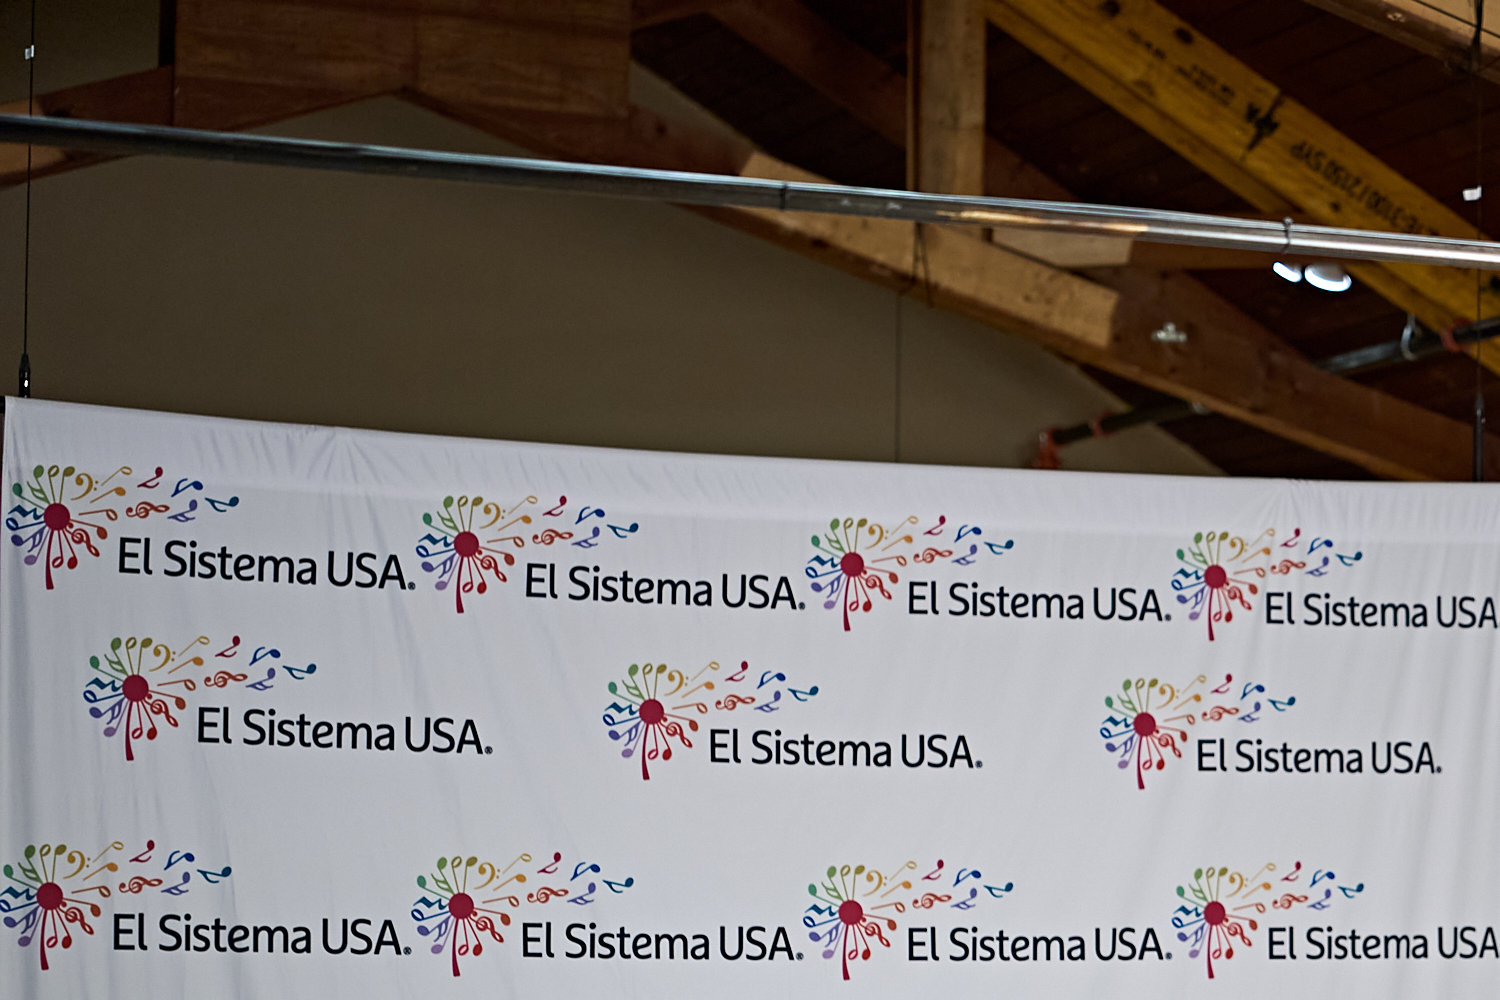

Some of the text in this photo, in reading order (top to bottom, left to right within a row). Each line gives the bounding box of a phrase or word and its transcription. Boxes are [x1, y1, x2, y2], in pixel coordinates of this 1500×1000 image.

[118, 536, 153, 576] El
[163, 539, 317, 586] Sistema
[525, 562, 559, 600] El
[568, 565, 713, 607] Sistema
[908, 580, 940, 615] El
[948, 581, 1084, 620] Sistema
[1266, 591, 1295, 625] El
[1303, 592, 1428, 628] Sistema
[197, 706, 233, 745] El
[242, 708, 395, 751] Sistema
[710, 728, 742, 764] El
[751, 729, 892, 768] Sistema
[1197, 737, 1228, 772] El
[1235, 738, 1363, 774] Sistema
[113, 912, 148, 951] El
[158, 913, 312, 954] Sistema
[522, 921, 555, 958] El
[565, 922, 710, 961] Sistema
[908, 926, 940, 962] El
[949, 926, 1086, 962] Sistema
[1268, 926, 1297, 960] El
[1306, 925, 1429, 960] Sistema
